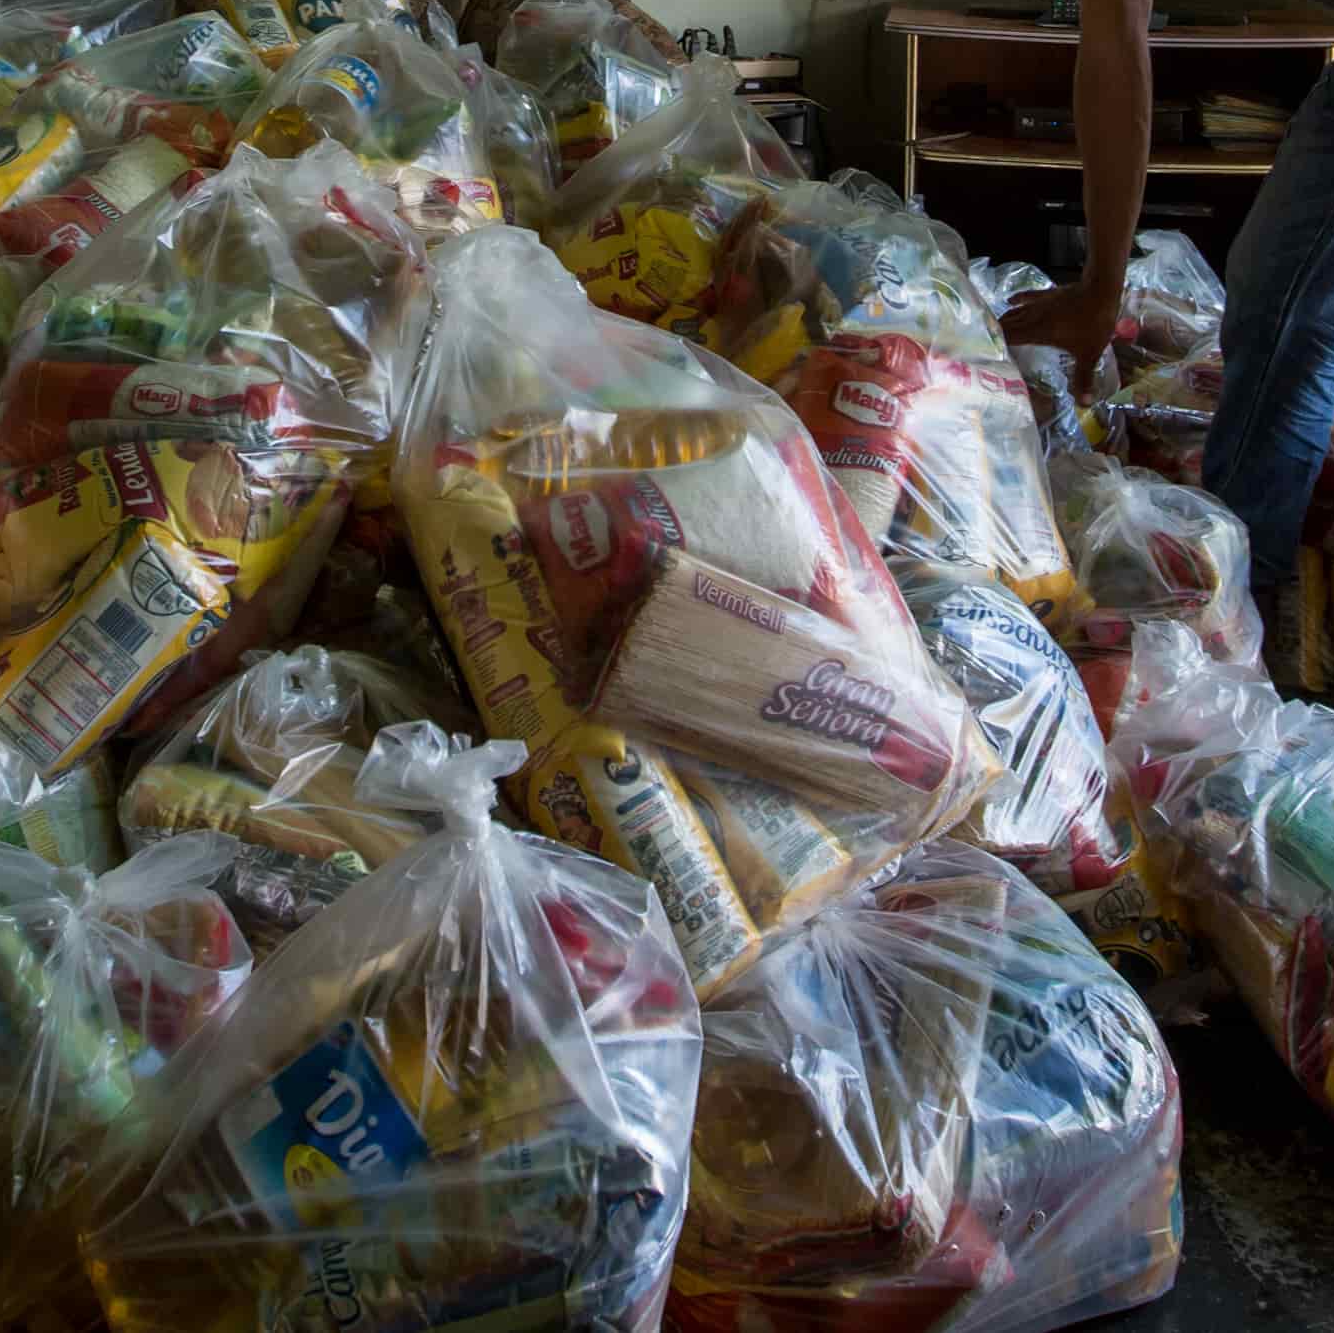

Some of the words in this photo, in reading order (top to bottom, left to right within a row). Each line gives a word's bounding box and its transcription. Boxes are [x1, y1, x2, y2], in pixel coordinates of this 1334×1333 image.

[136, 388, 179, 410] Mary
[841, 383, 898, 425] Mary
[694, 571, 787, 634] Vermicelli
[765, 683, 885, 743] Señora
[805, 660, 896, 713] Gran
